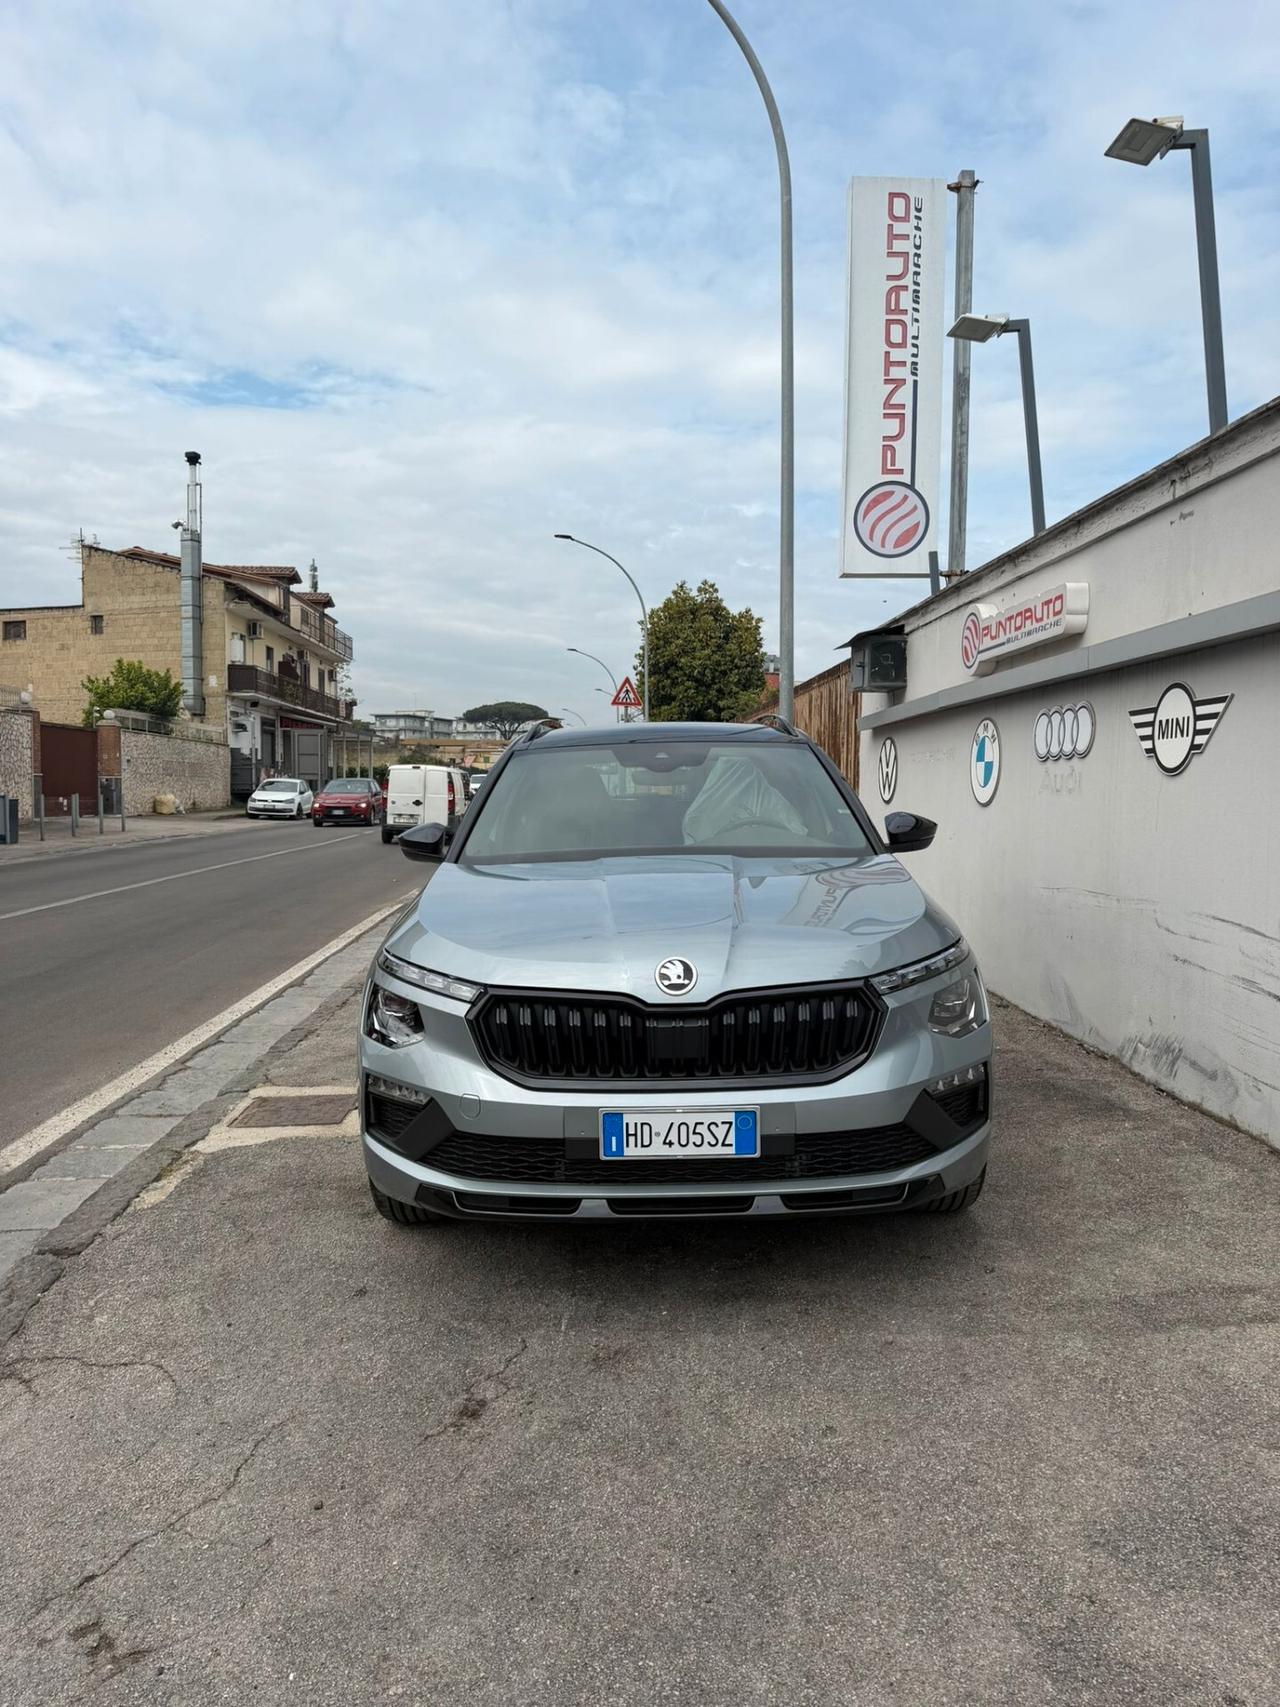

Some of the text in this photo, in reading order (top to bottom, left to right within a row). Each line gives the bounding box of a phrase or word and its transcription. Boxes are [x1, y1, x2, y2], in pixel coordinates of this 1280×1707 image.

[910, 196, 924, 379] MULTIMARCHE
[881, 191, 912, 476] PUNTOAUTO
[981, 593, 1064, 645] PUNTOAUTO
[1157, 714, 1191, 741] MINI
[625, 1121, 734, 1149] HD 405SZ
